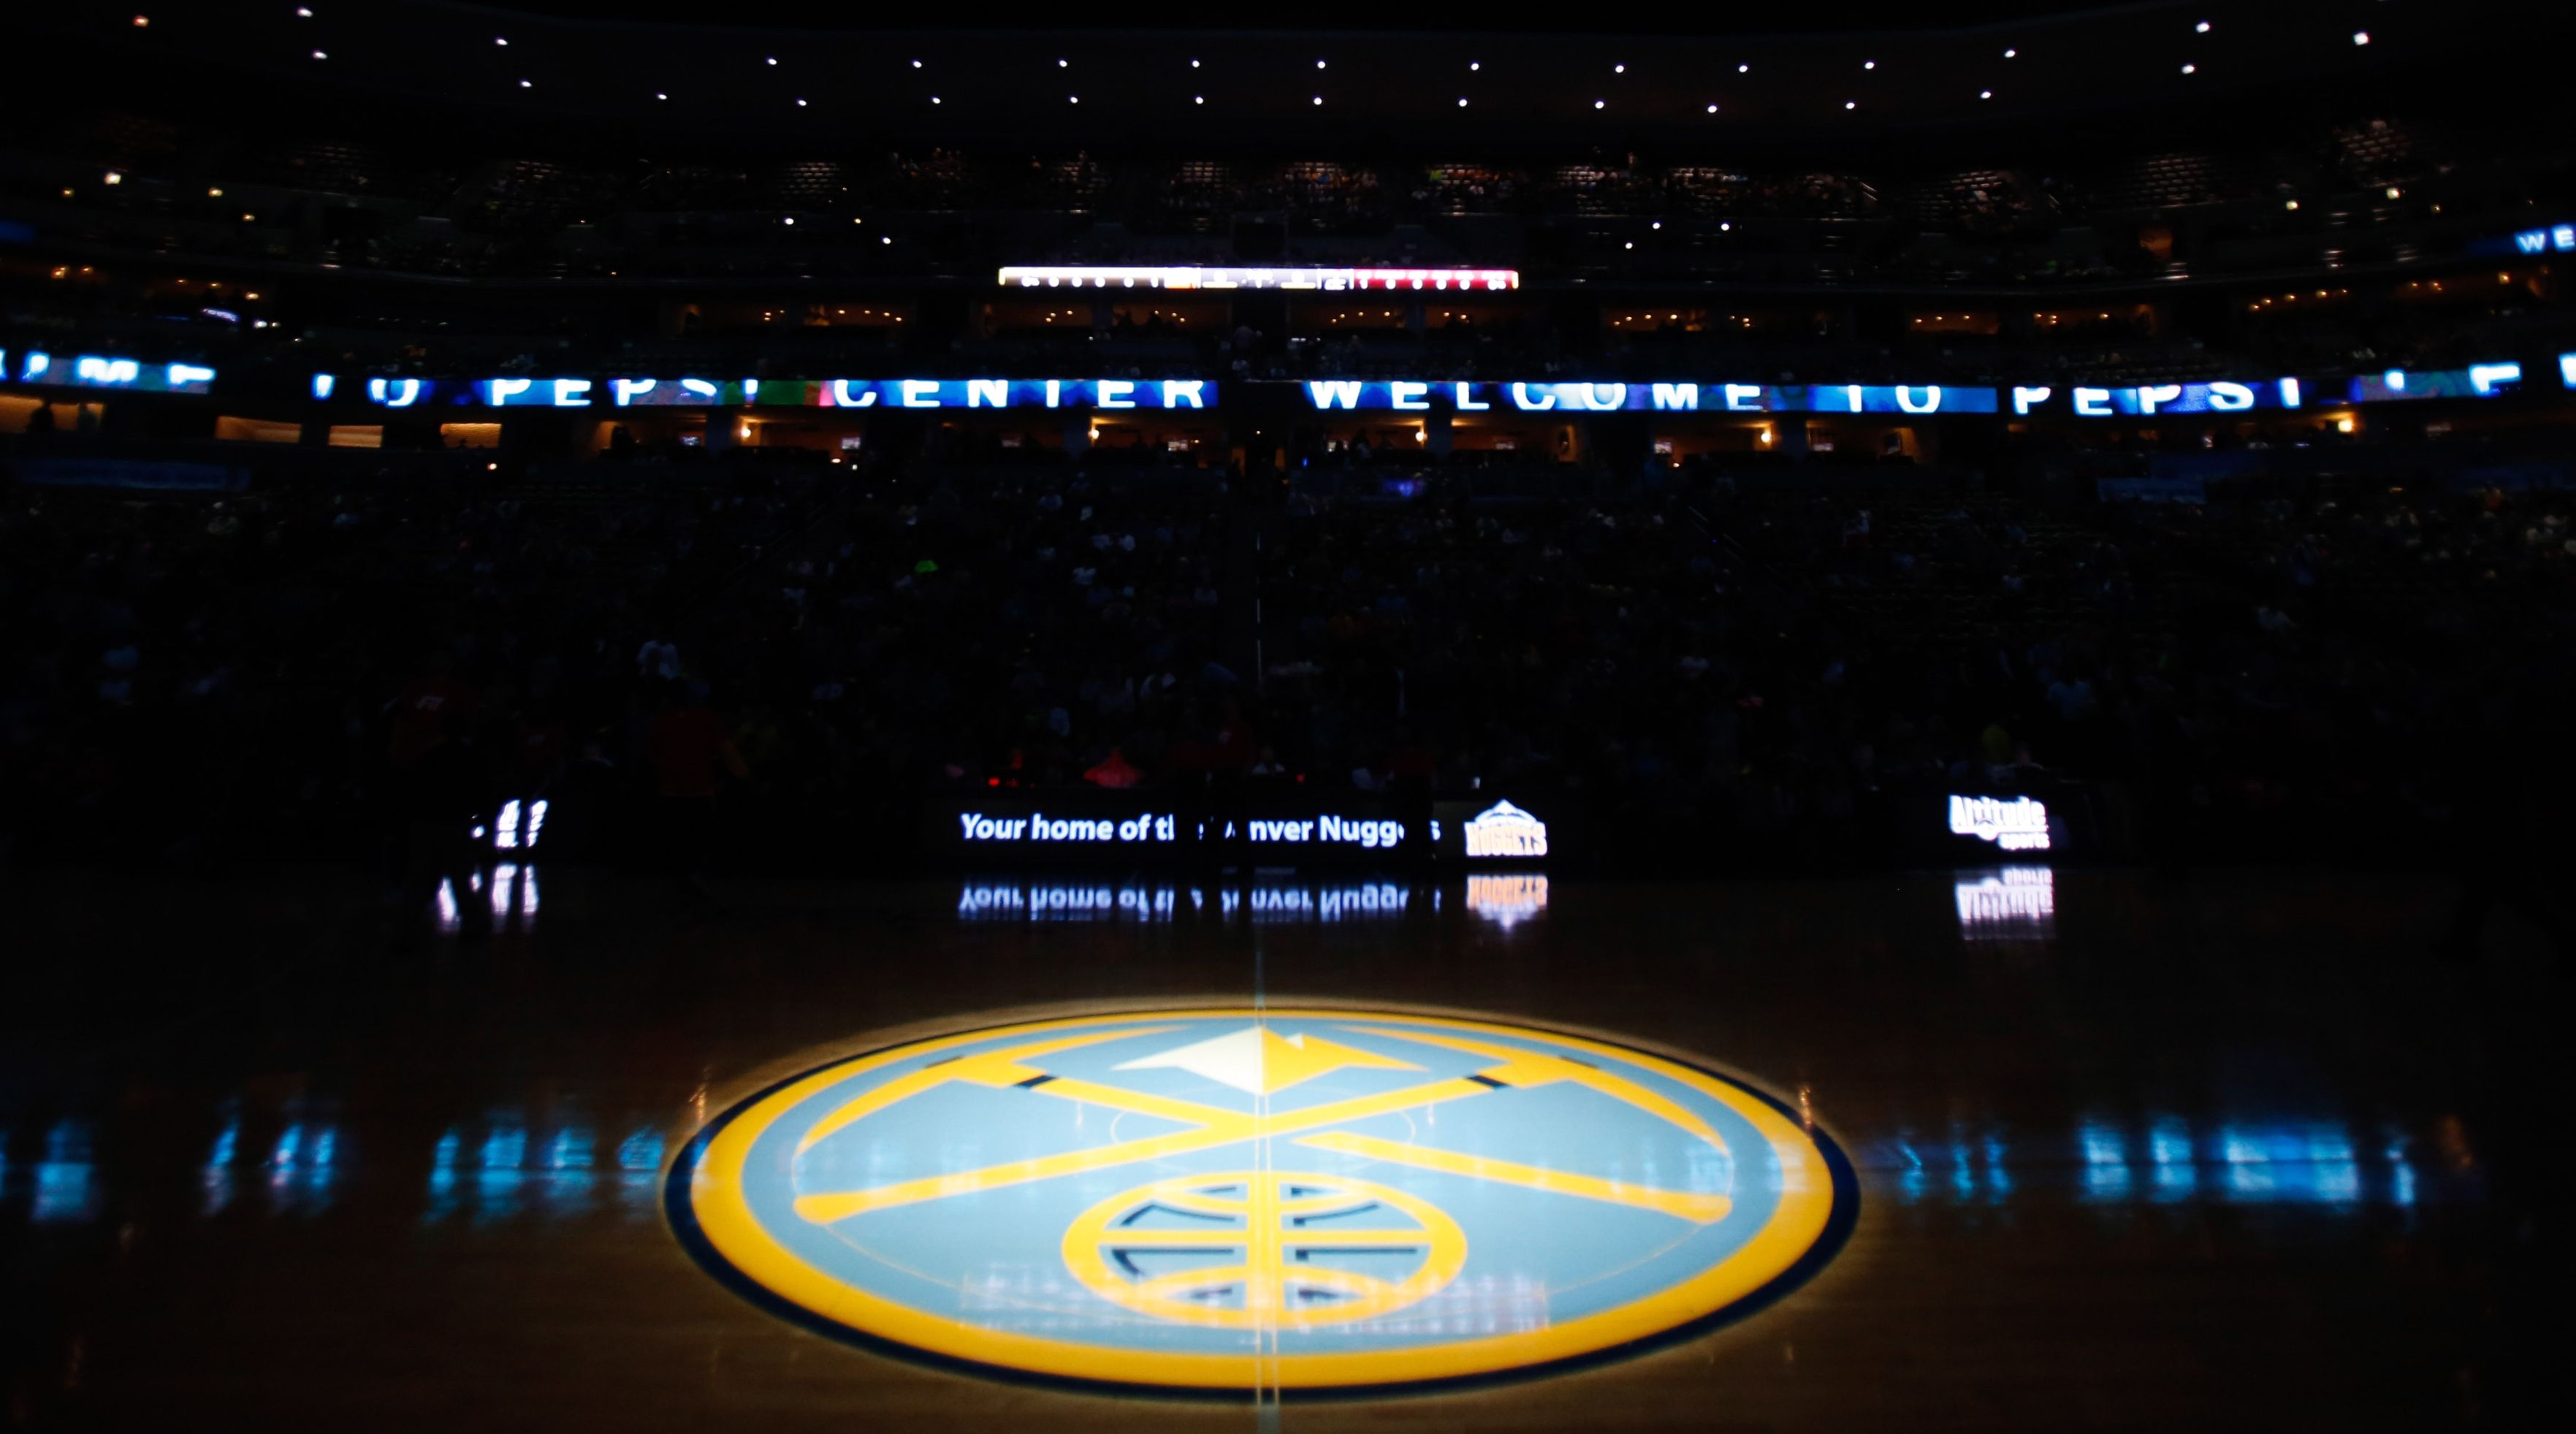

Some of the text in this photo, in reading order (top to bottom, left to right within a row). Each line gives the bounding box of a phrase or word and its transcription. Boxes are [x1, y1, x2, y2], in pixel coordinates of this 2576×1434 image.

[834, 379, 1205, 408] CENTER
[1310, 381, 1764, 411] WELCOME
[2013, 377, 2300, 415] PEPSI
[961, 813, 1026, 839] Your
[1032, 813, 1113, 840] home
[1119, 813, 1151, 840] of
[1948, 794, 2047, 833] Altitude
